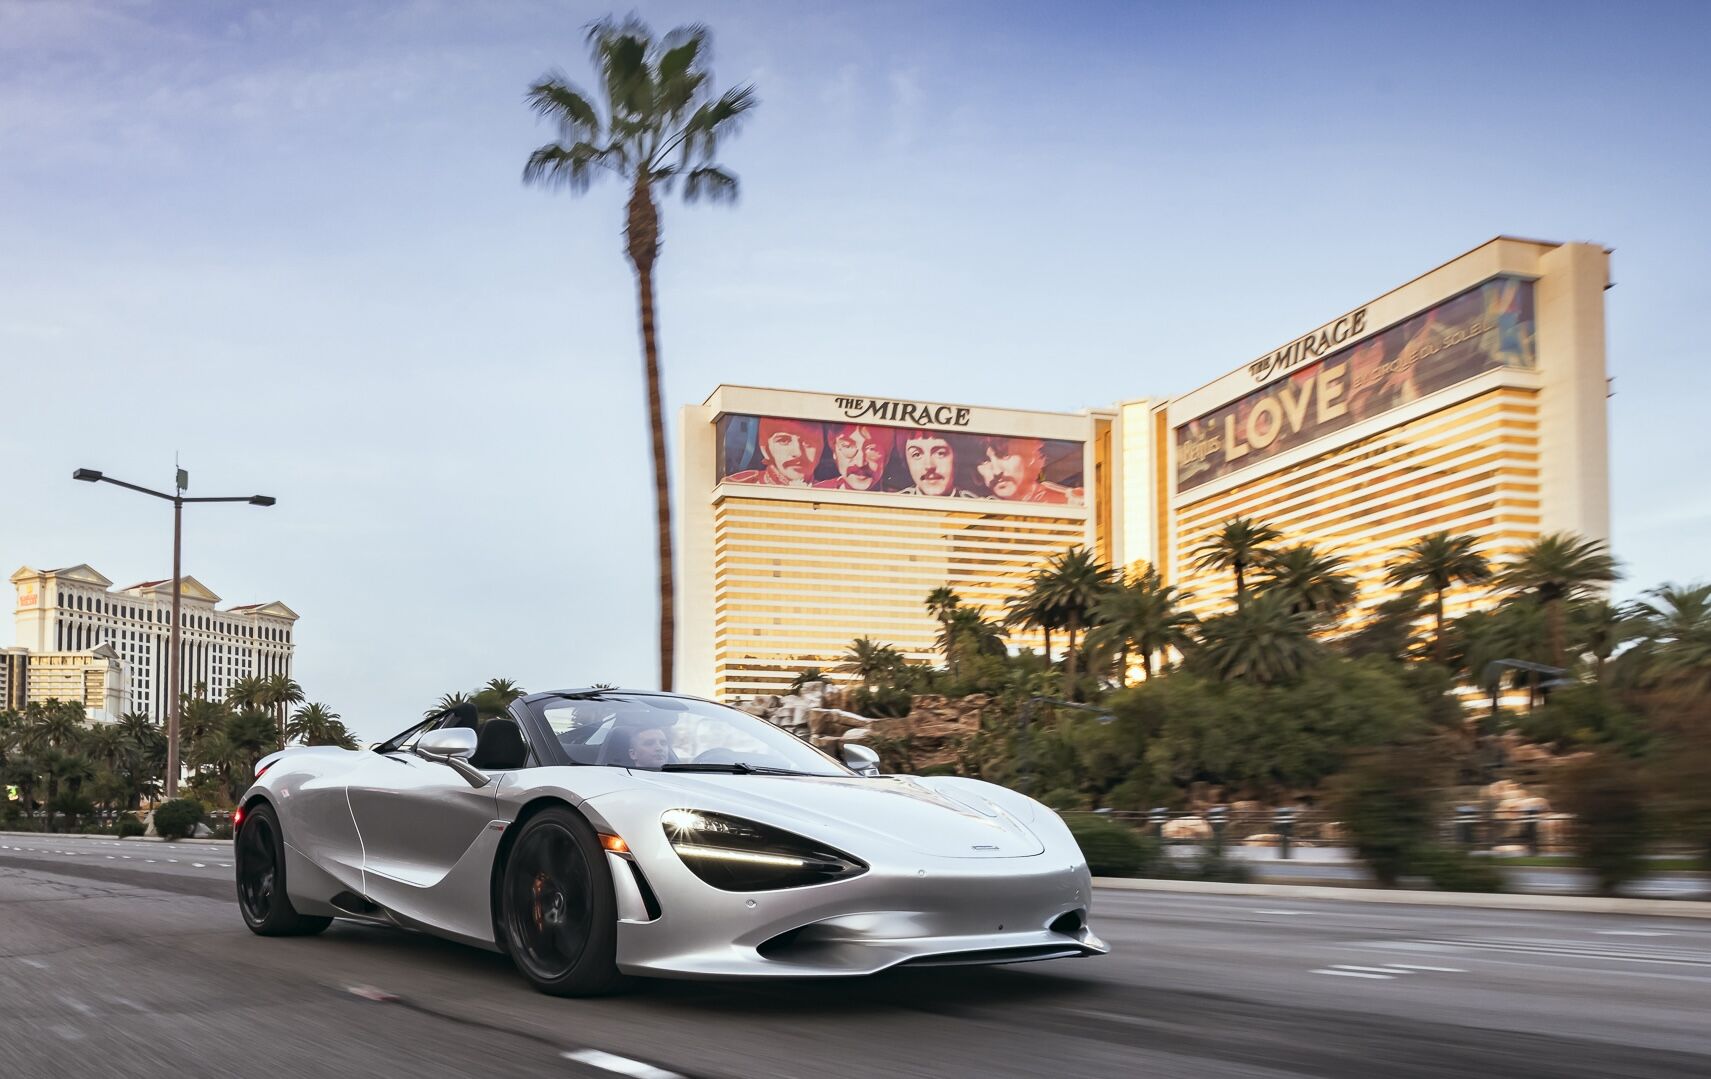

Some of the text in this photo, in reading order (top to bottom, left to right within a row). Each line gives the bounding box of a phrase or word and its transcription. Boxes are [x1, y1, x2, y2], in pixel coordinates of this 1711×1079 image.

[1248, 308, 1367, 382] THE MIRAGE
[834, 397, 971, 426] THE MIRAGE
[1224, 361, 1349, 463] LOVE
